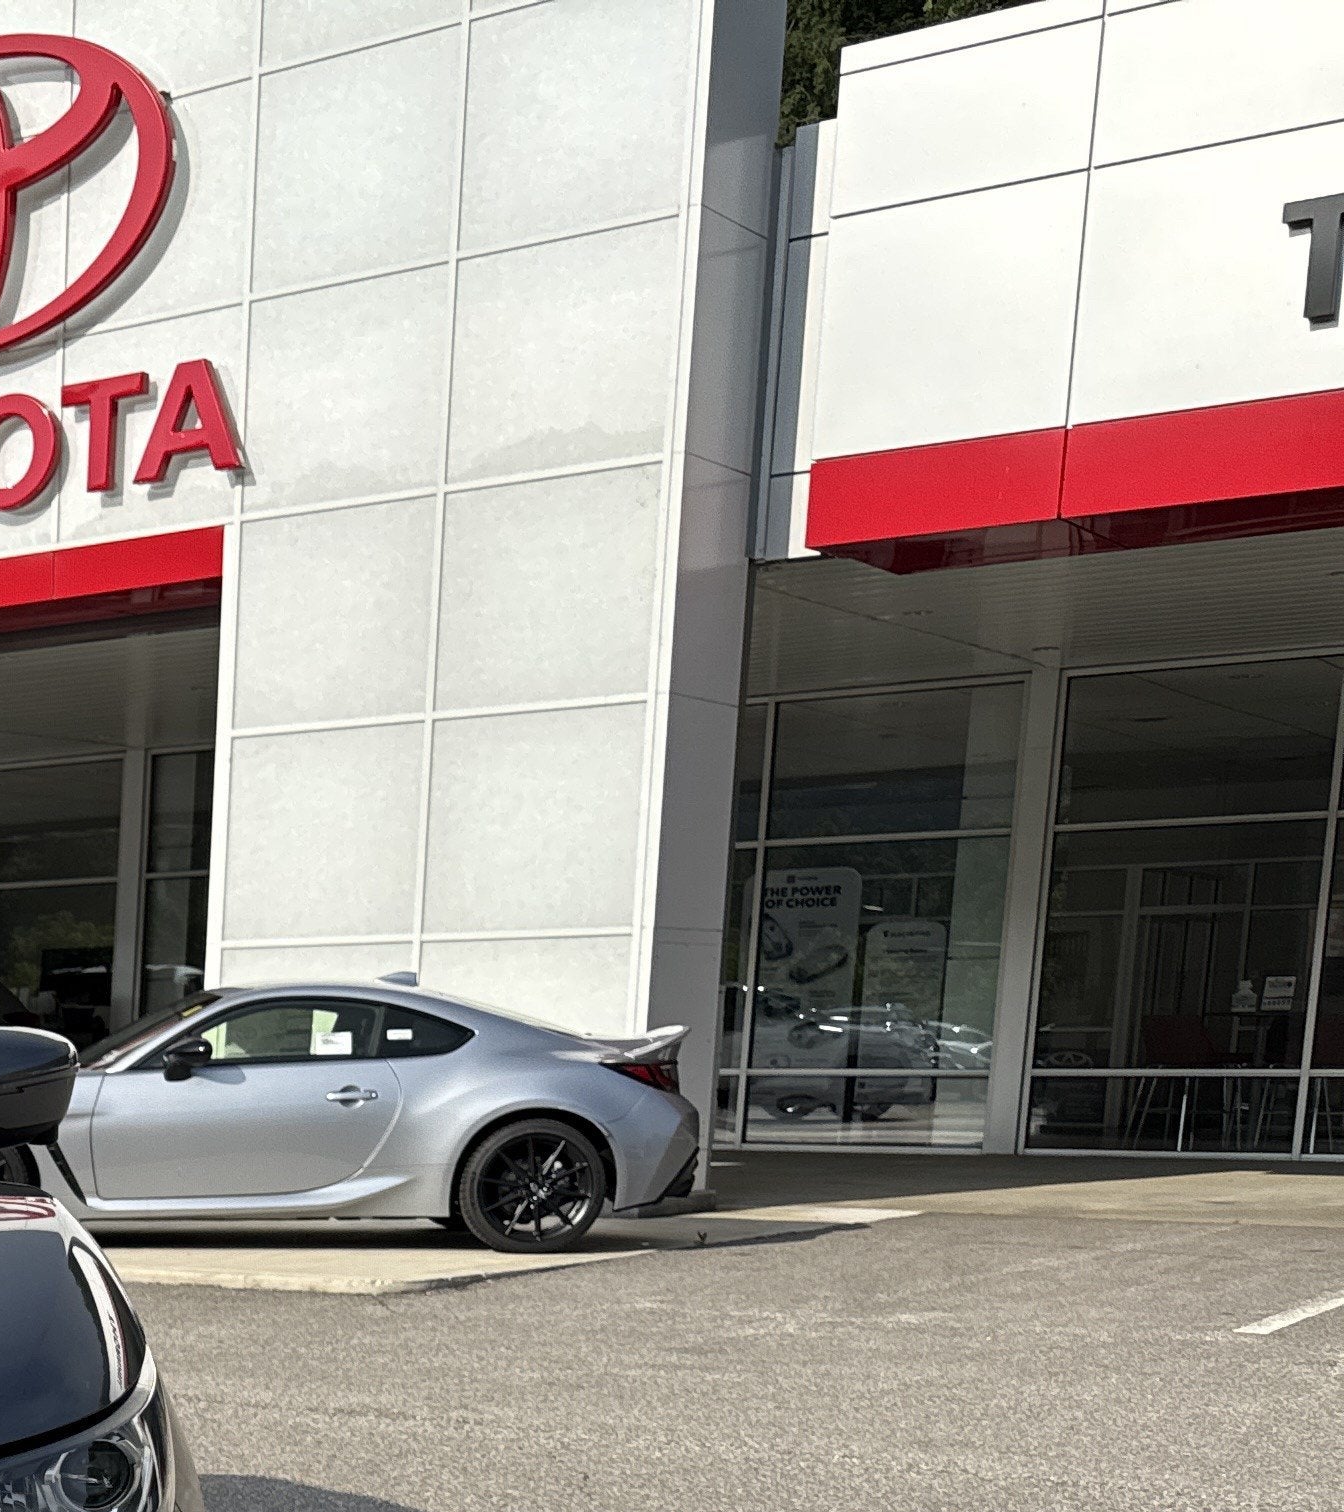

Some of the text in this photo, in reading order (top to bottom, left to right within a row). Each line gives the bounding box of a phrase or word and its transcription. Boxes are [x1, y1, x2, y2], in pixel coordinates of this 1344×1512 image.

[791, 885, 843, 897] POWER
[764, 896, 838, 909] OF CHOICE
